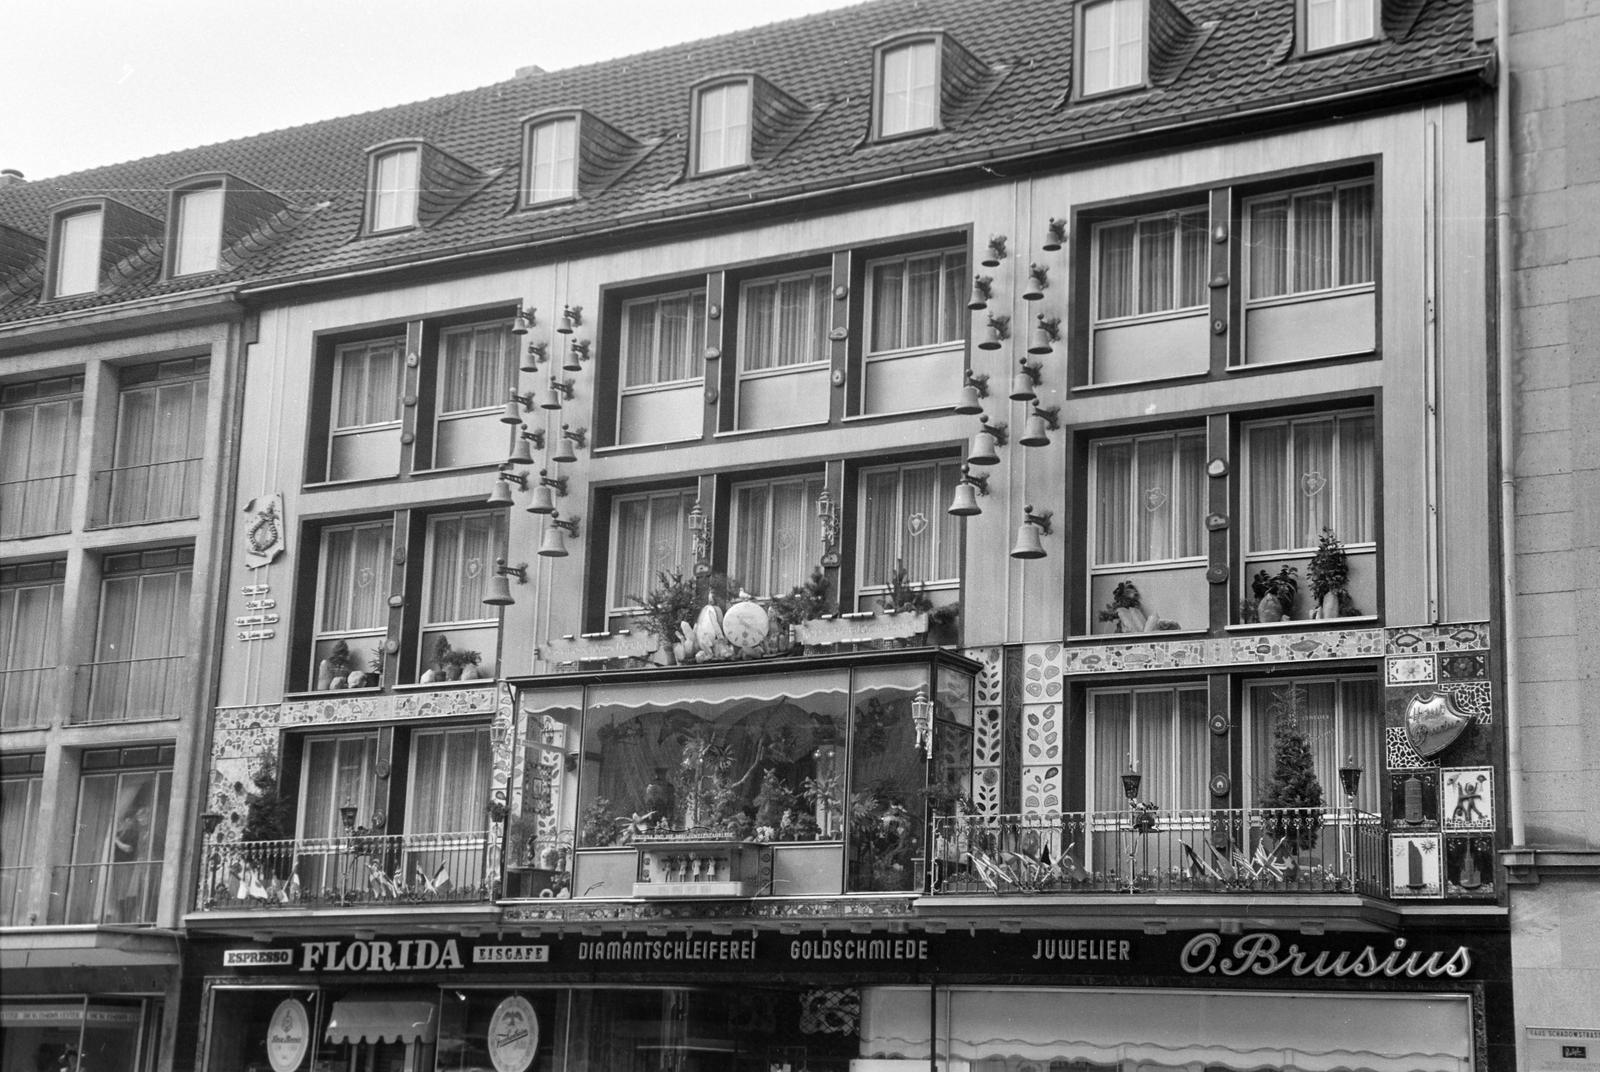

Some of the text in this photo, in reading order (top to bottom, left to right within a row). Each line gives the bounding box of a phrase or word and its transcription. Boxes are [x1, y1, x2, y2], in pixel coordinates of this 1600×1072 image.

[227, 951, 289, 964] ESPRESSO
[299, 939, 464, 972] FLORIDA
[478, 947, 543, 961] EISCAFE
[578, 940, 756, 961] DIAMANTSCHLEIFEREI
[790, 939, 928, 960] GOLDSCHMIEDE
[1032, 939, 1130, 961] JUWELIER
